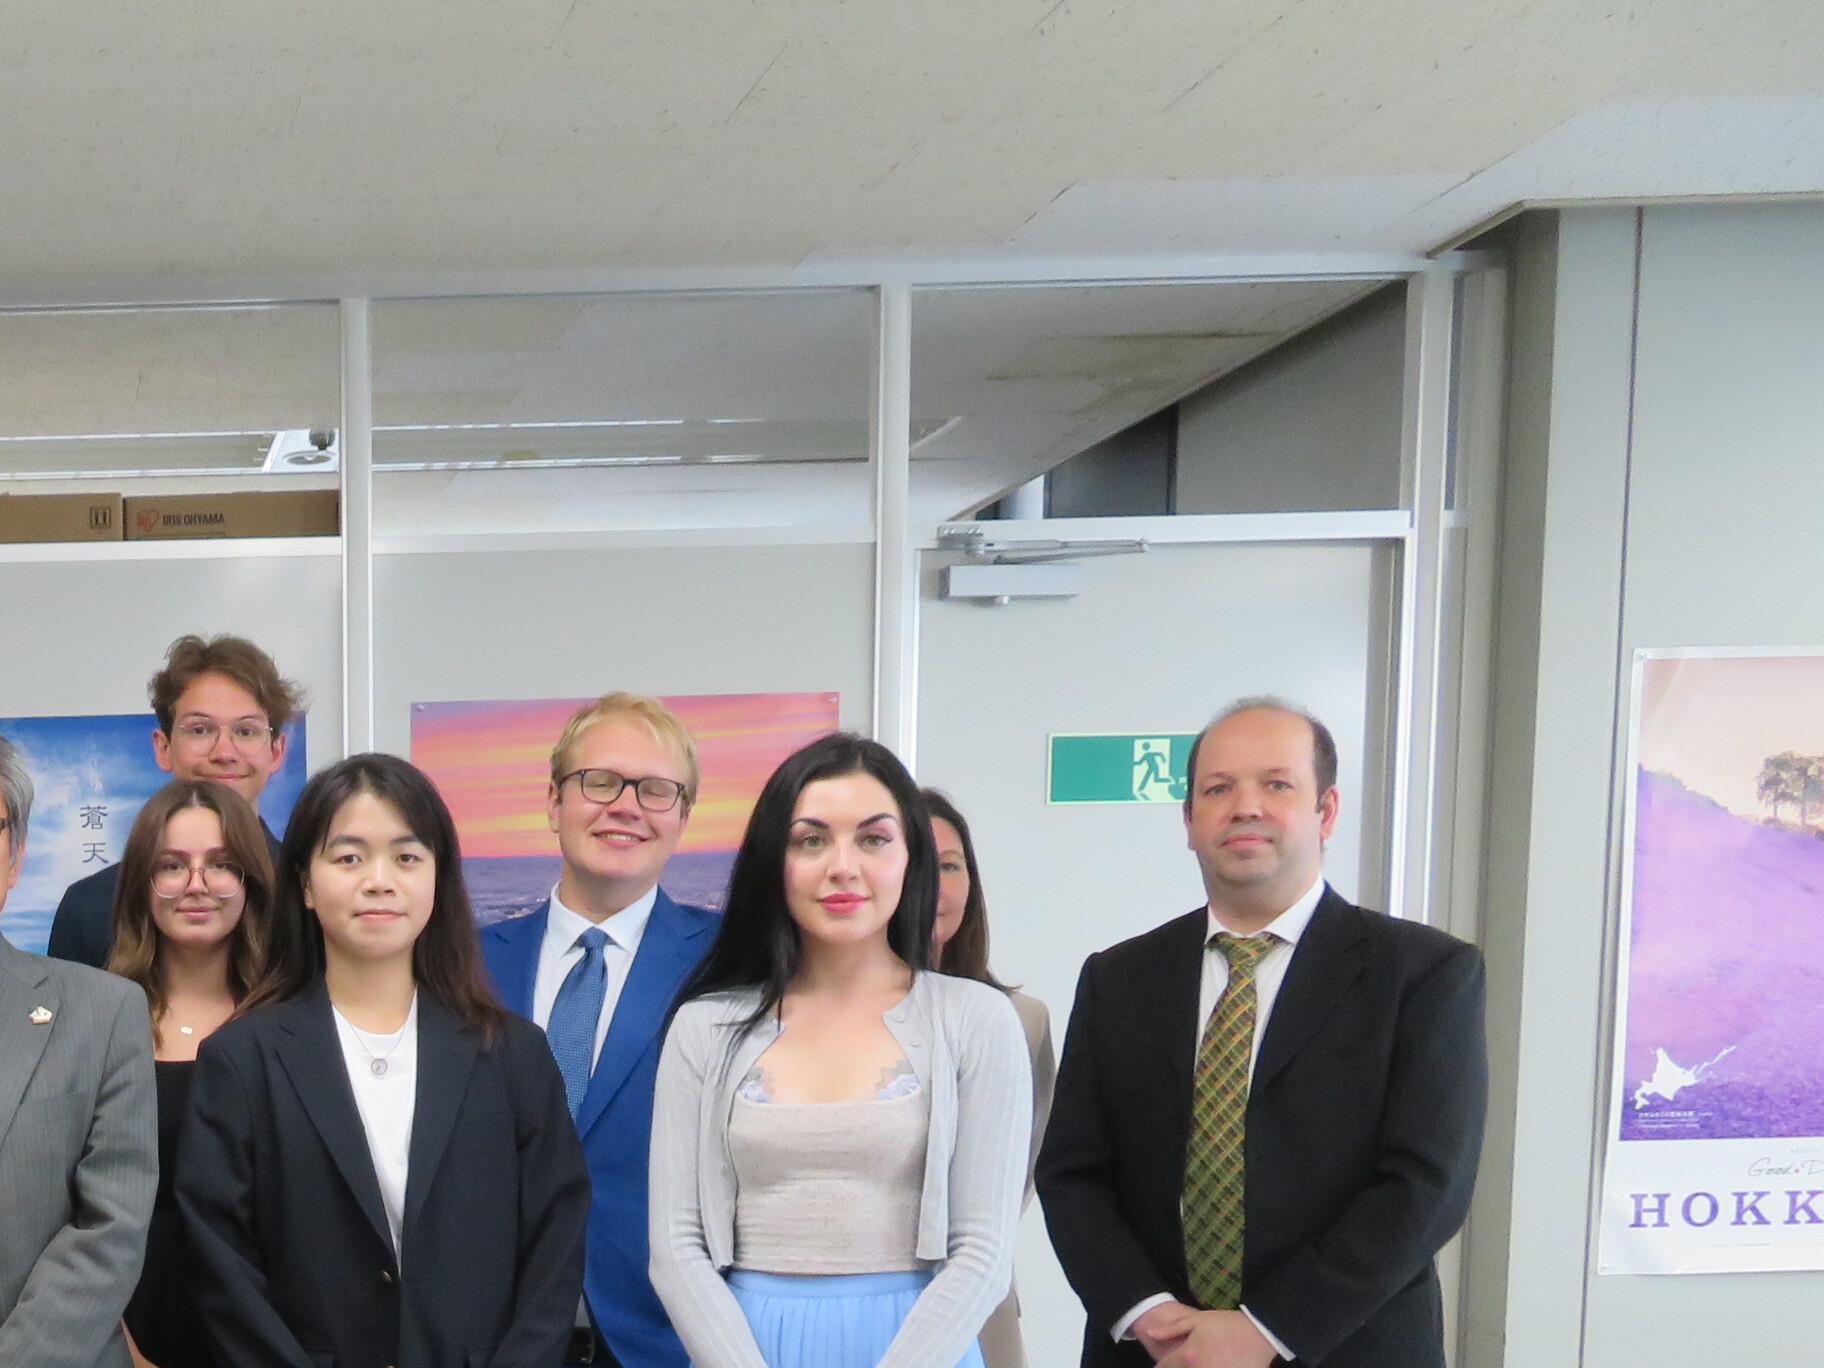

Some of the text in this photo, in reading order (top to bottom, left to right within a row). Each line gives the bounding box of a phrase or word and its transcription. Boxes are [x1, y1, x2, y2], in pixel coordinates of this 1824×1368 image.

[162, 513, 225, 526] IRIS OHYAMA
[1628, 1190, 1824, 1228] HOKK
